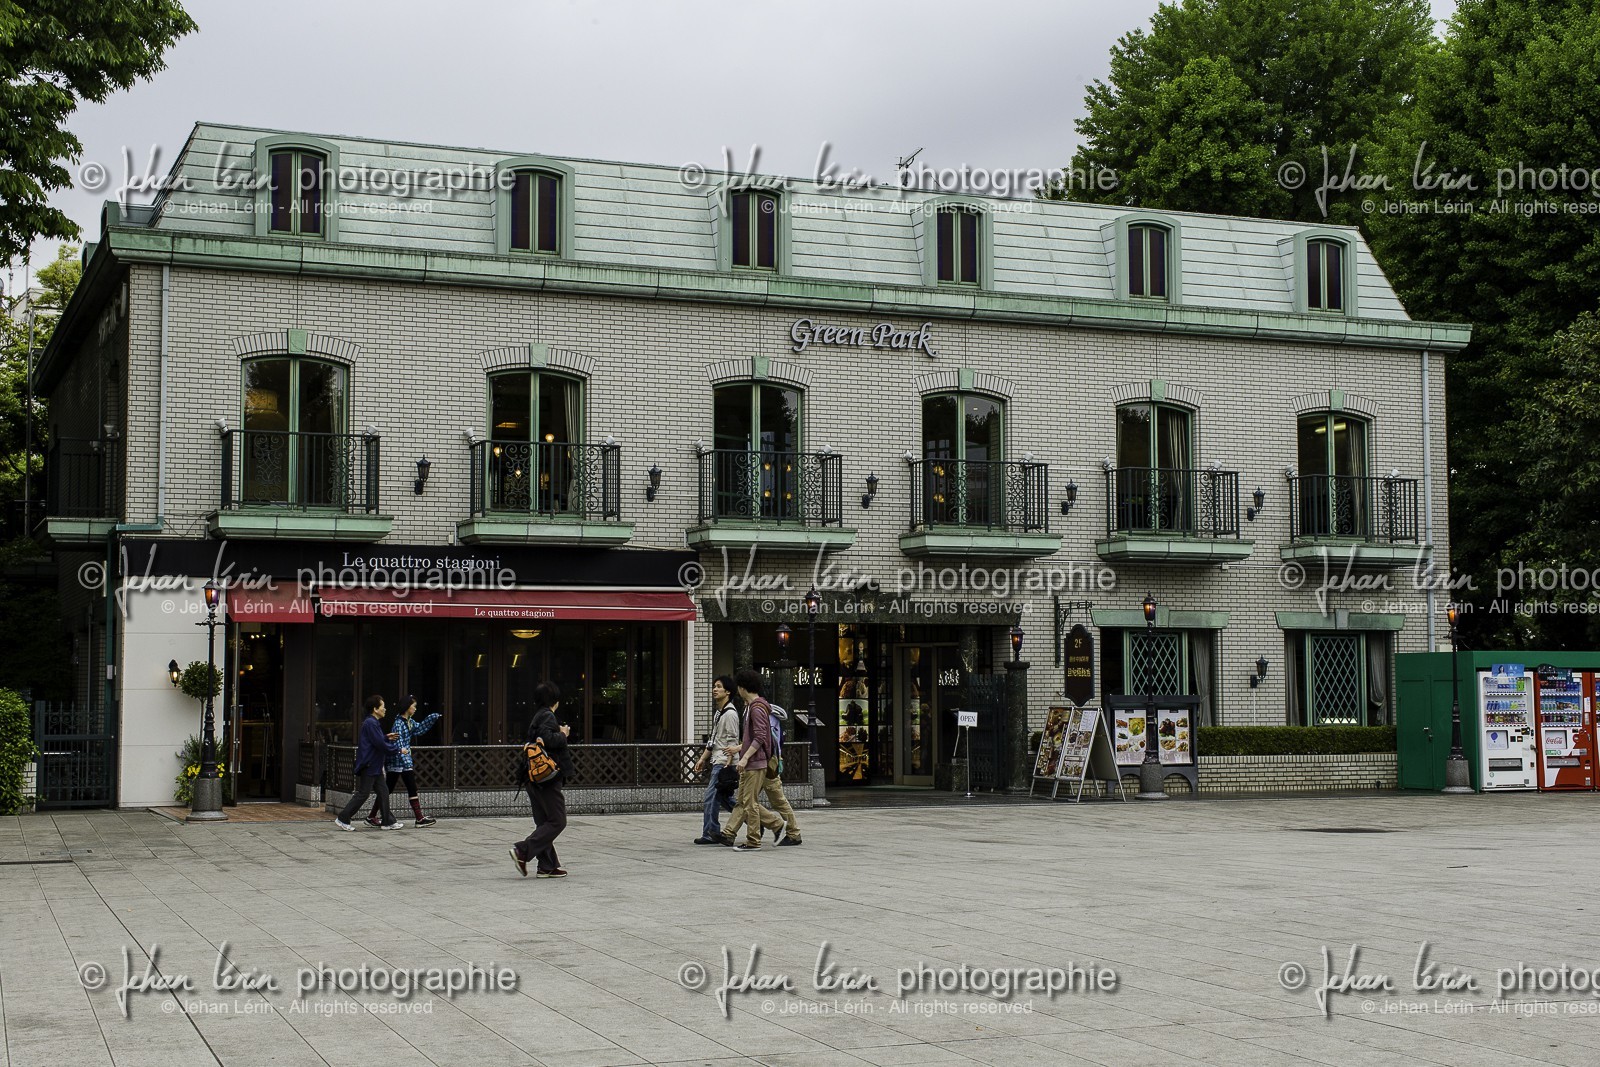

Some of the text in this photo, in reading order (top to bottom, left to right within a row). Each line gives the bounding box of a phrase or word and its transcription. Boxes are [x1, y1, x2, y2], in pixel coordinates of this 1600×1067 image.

[791, 318, 938, 357] Green Park
[342, 552, 501, 572] Le quattro stagioni
[474, 607, 555, 619] Le quattro stagioni
[1074, 638, 1083, 649] 2F
